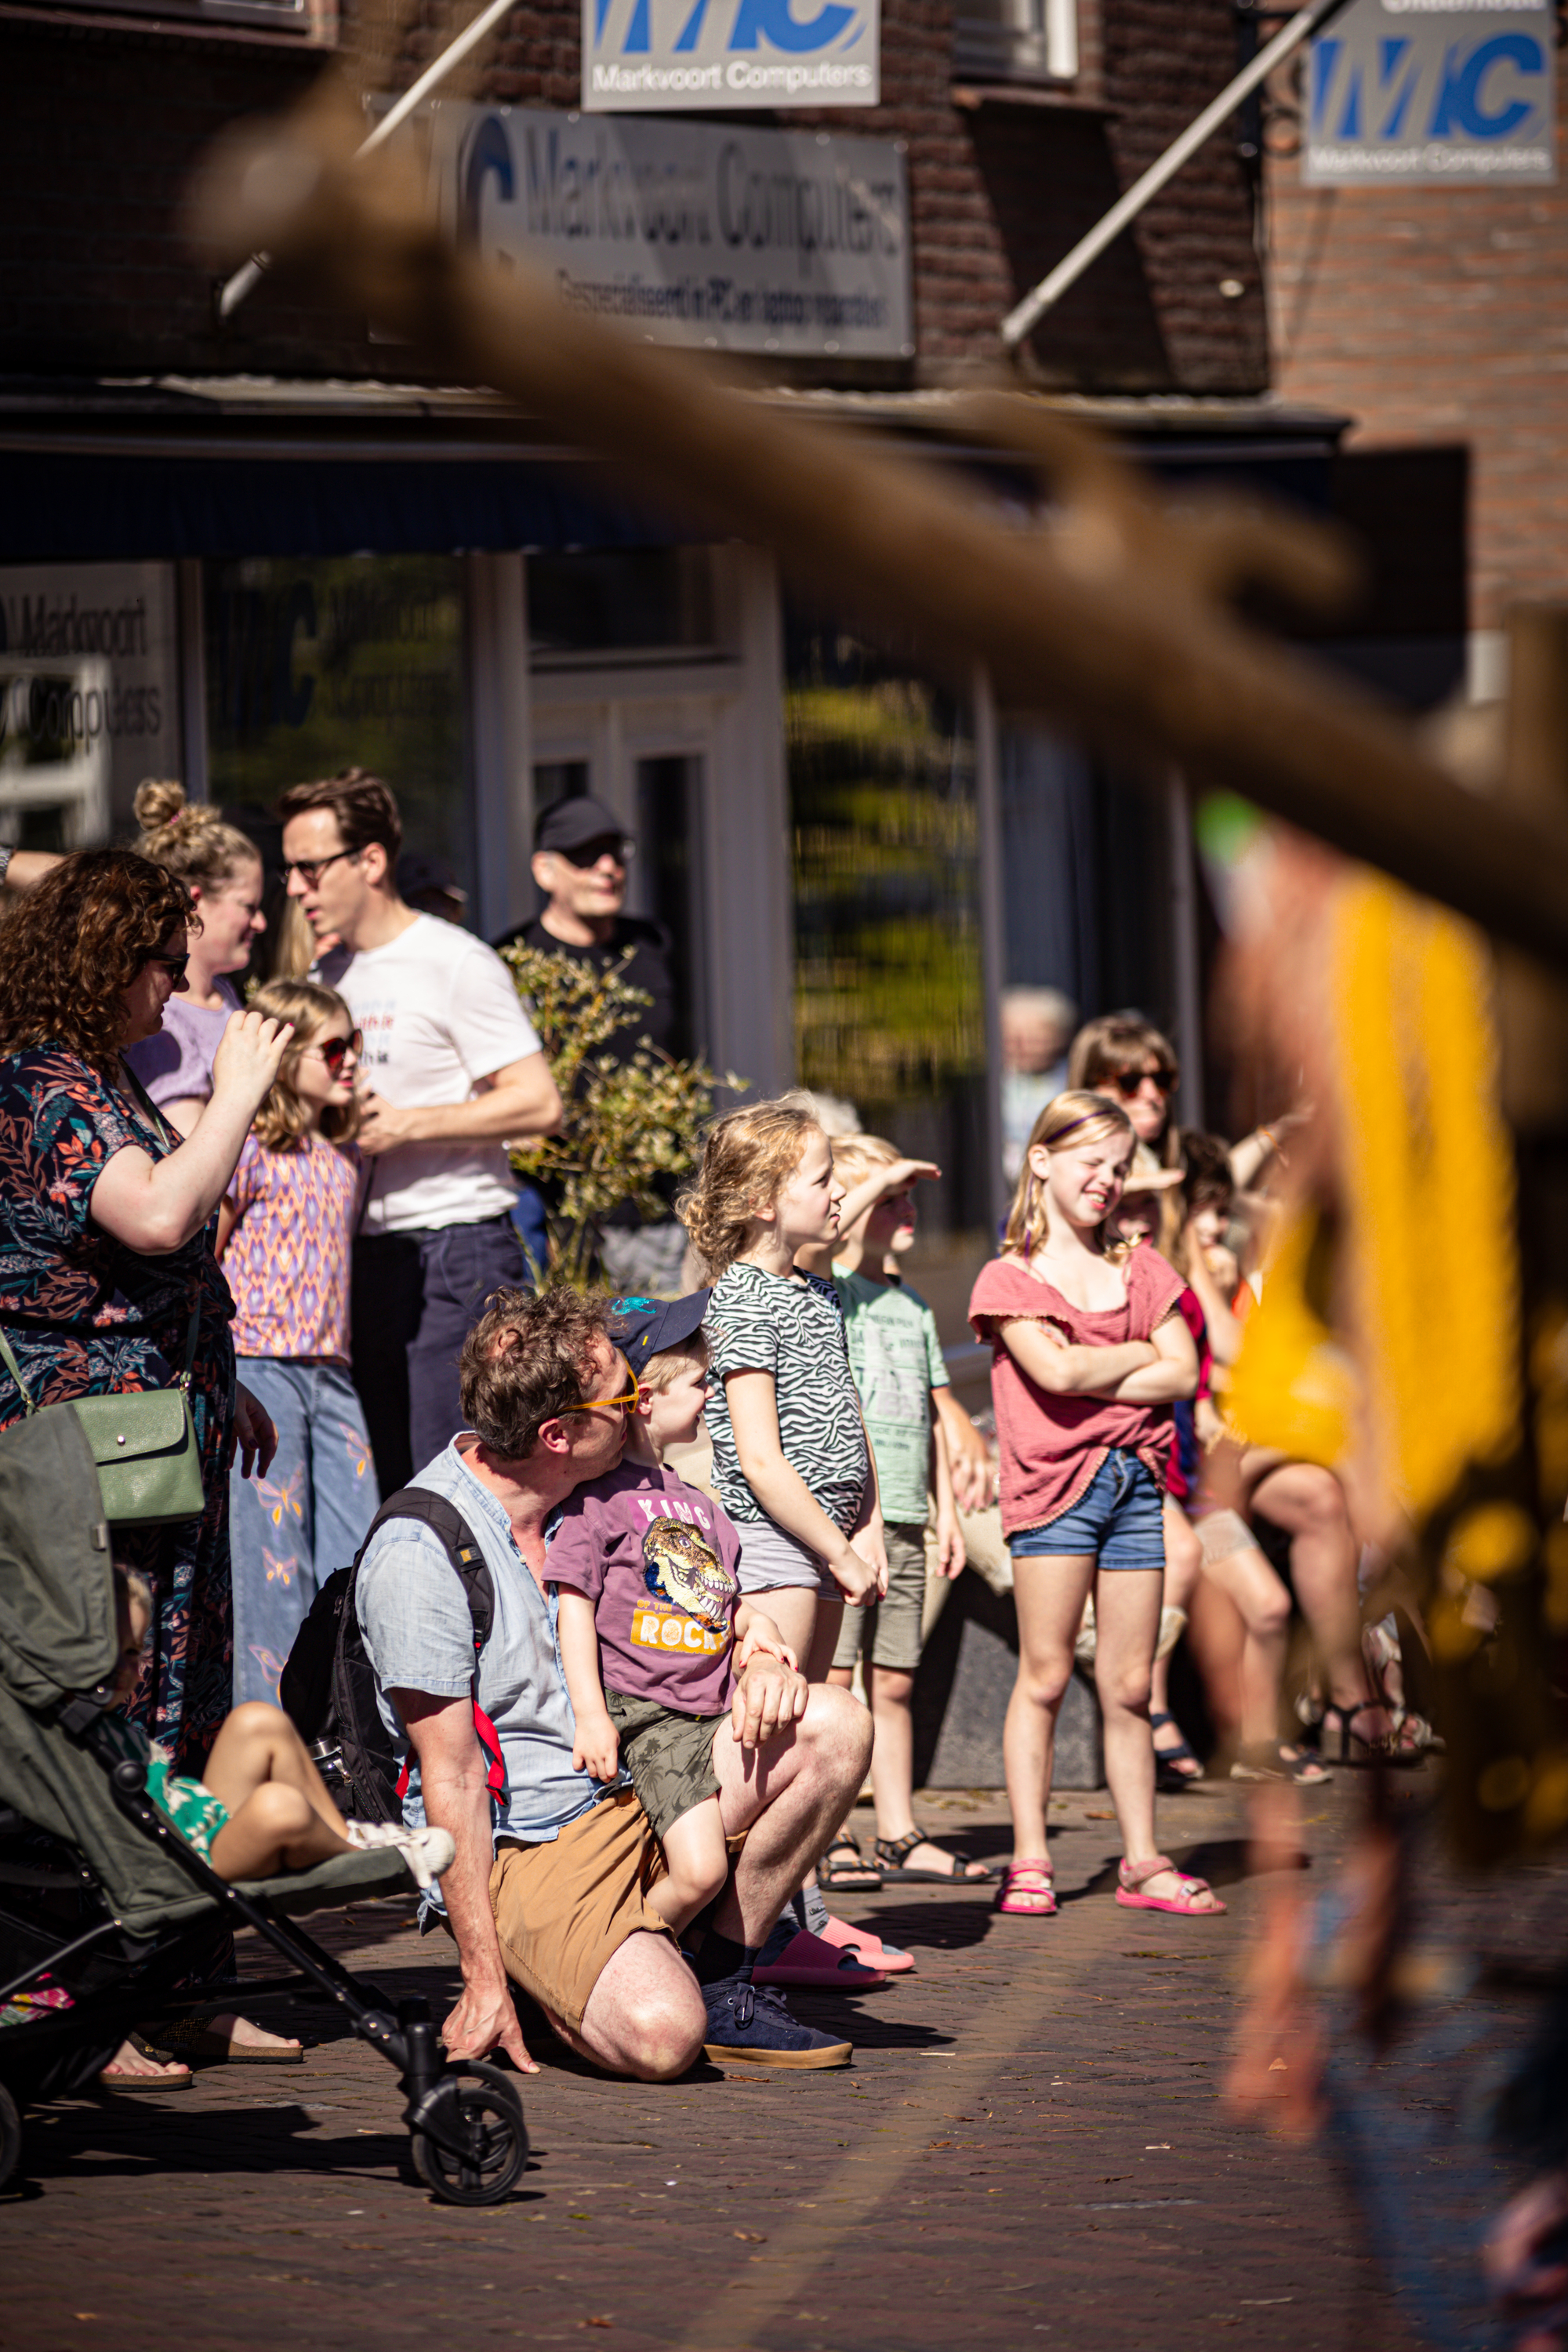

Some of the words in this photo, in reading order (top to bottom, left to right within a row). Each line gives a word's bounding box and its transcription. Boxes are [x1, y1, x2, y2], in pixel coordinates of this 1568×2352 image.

[593, 64, 722, 93] Markvoort
[726, 60, 873, 93] Computers
[1312, 33, 1544, 140] MC
[637, 1498, 711, 1530] KING
[637, 1599, 651, 1609] OF
[653, 1602, 672, 1612] THE
